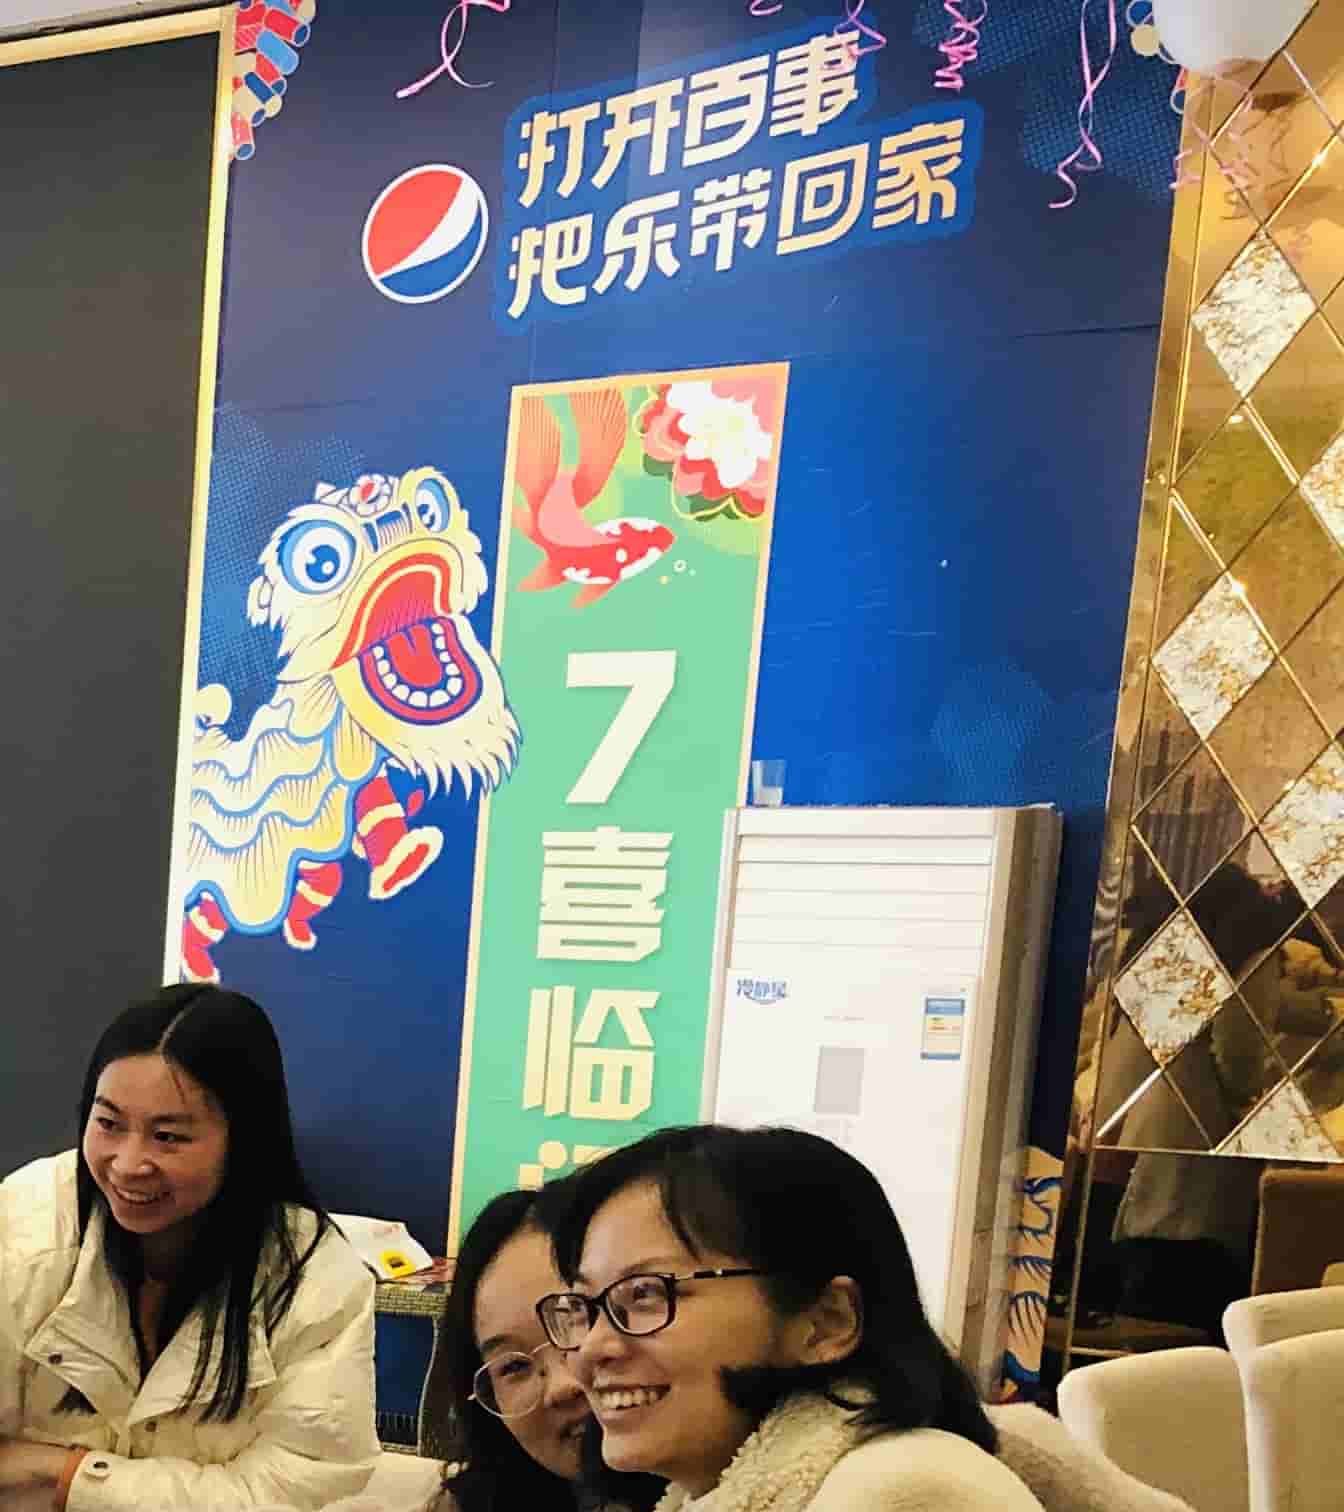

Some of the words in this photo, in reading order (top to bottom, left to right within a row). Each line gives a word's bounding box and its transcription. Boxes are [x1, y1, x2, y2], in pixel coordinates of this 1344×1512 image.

[507, 118, 965, 319] 把乐带回家
[518, 30, 861, 208] 打开百事
[518, 649, 678, 1192] 7喜临
